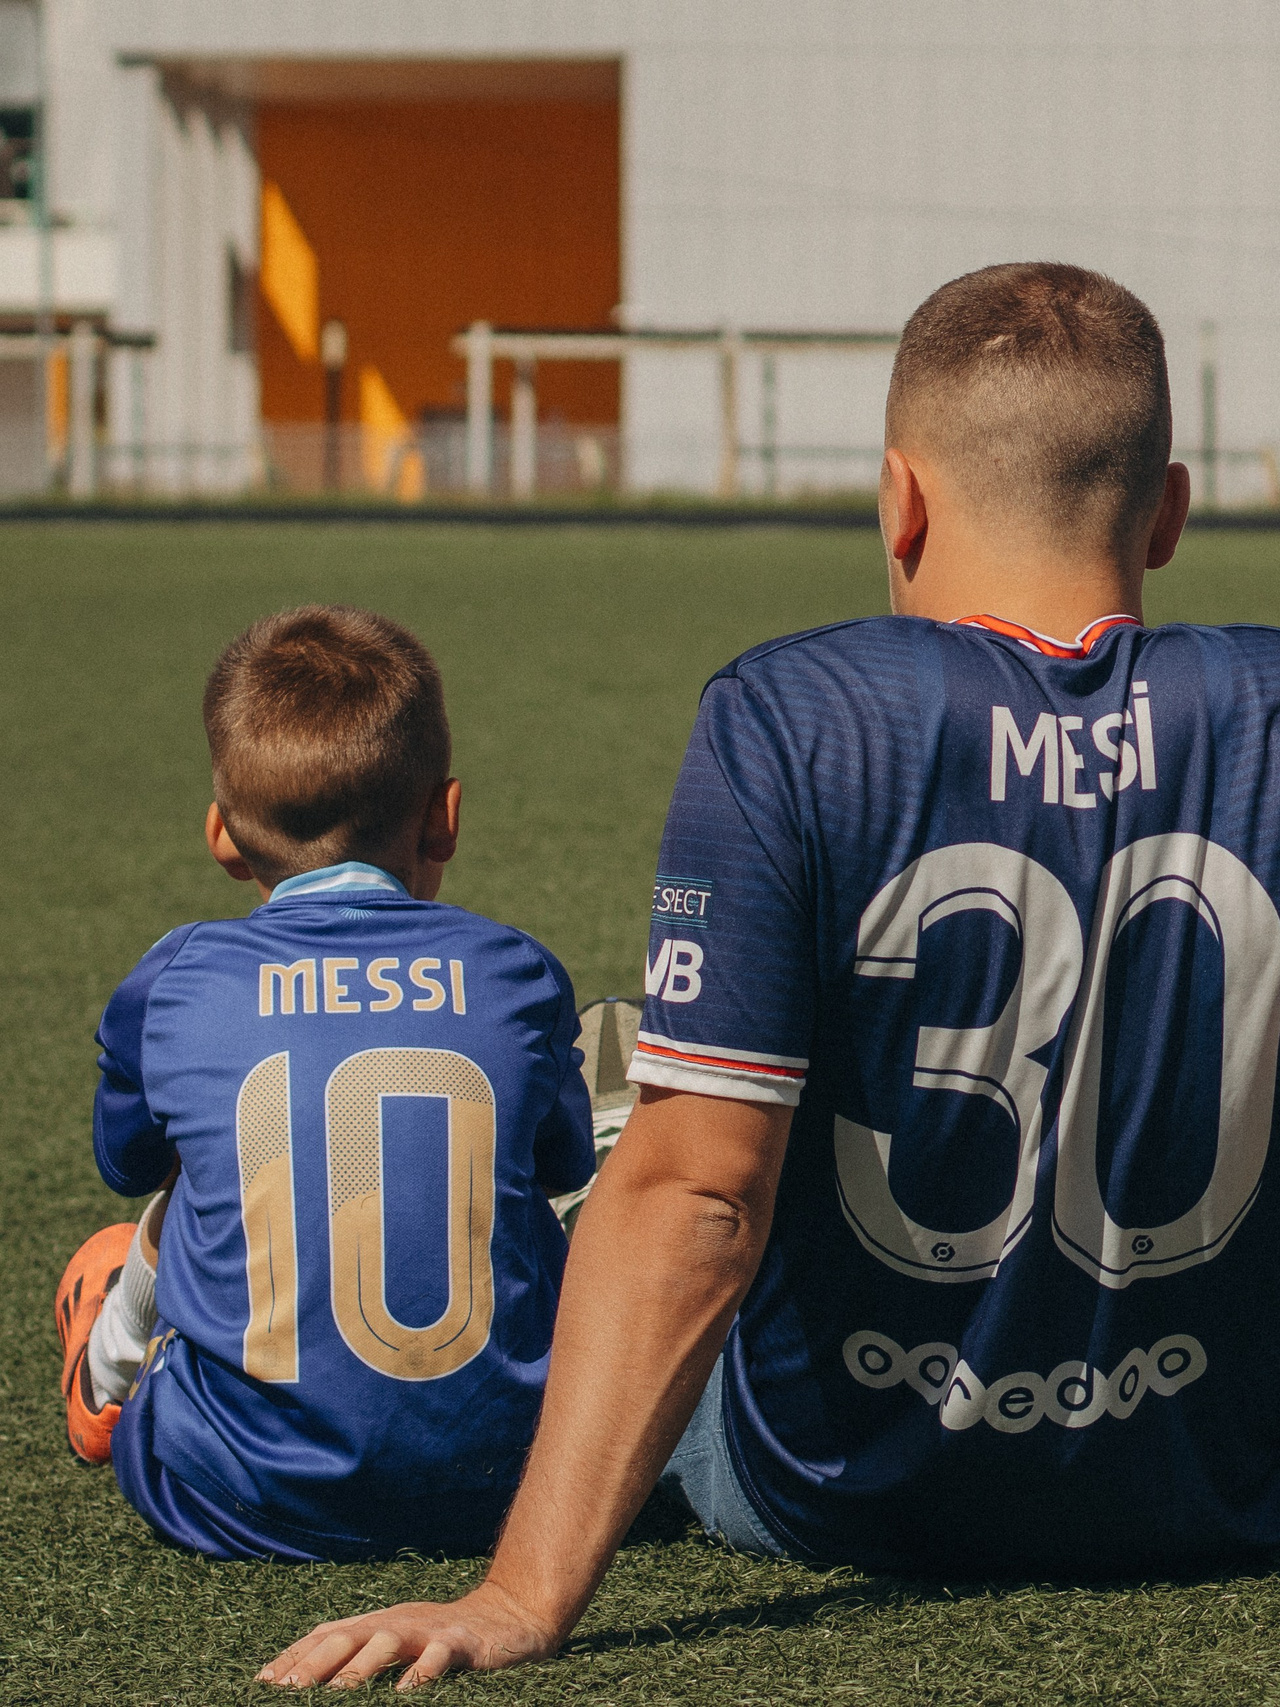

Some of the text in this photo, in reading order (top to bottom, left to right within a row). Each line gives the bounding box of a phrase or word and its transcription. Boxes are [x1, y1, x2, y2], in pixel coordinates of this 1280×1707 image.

[259, 957, 467, 1017] MESSI
[236, 1047, 496, 1383] 10
[850, 1336, 1200, 1427] ooredoo
